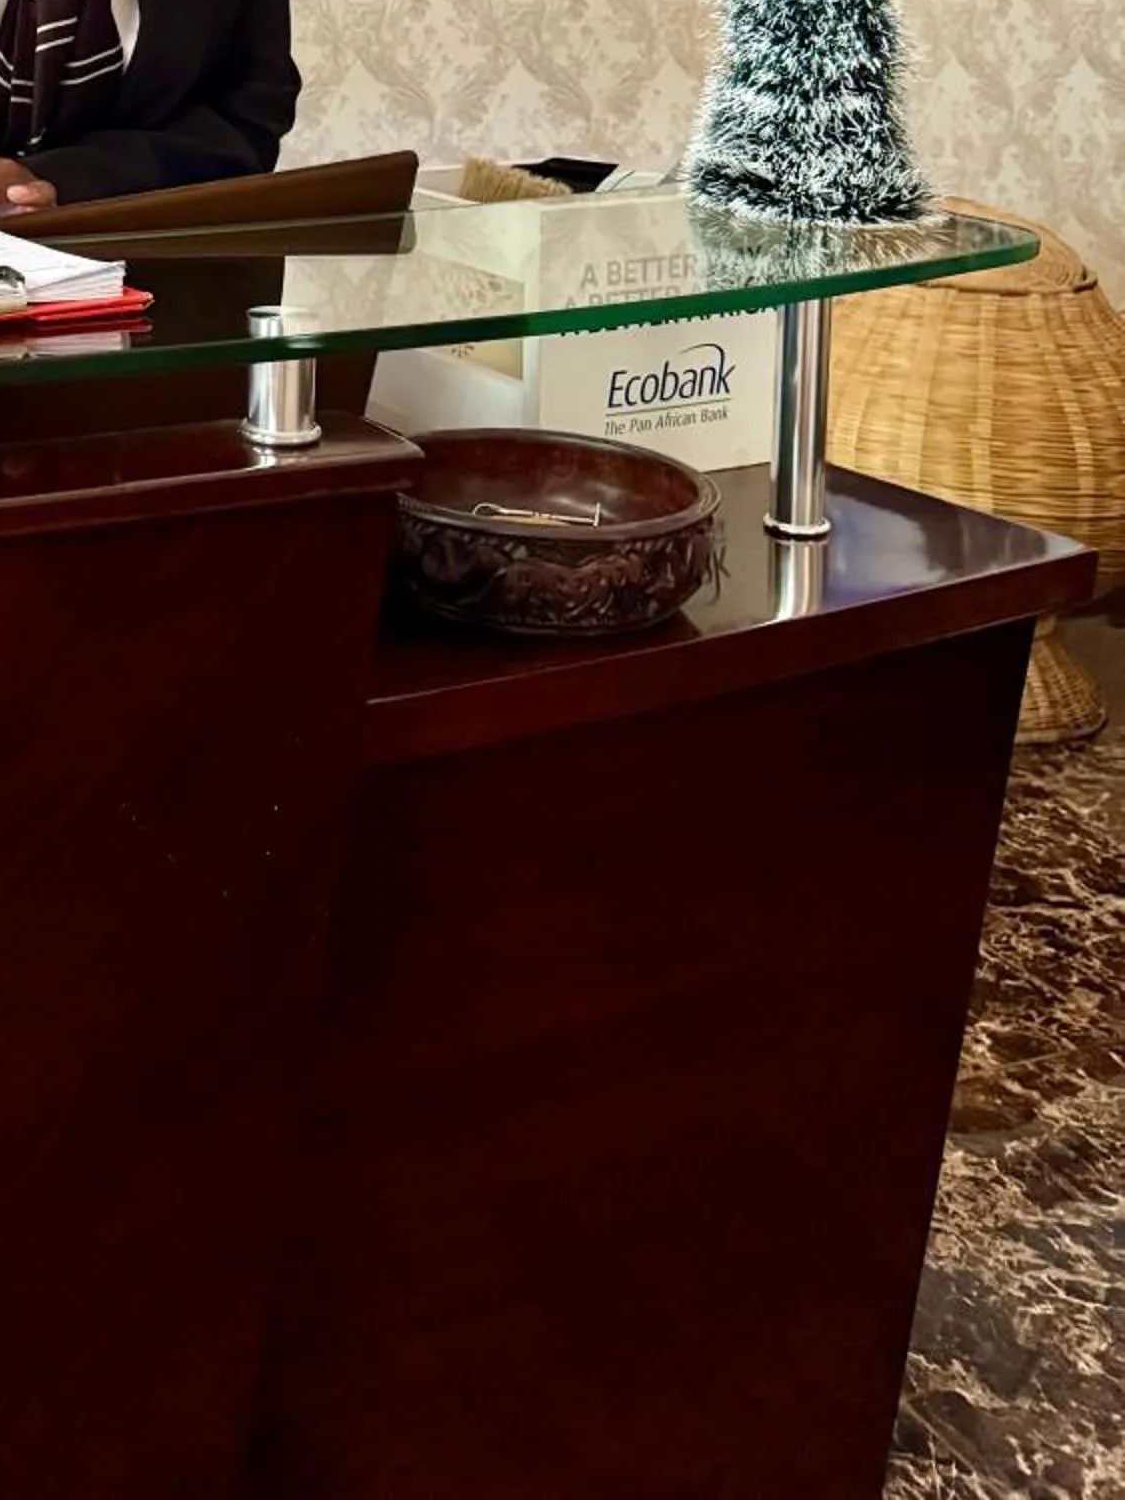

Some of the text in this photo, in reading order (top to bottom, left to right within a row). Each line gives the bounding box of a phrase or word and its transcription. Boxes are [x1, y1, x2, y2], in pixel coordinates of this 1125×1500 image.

[580, 263, 599, 289] A
[607, 254, 696, 286] BETTER
[607, 343, 736, 408] Ecobank
[604, 405, 730, 436] The Pan African Bank
